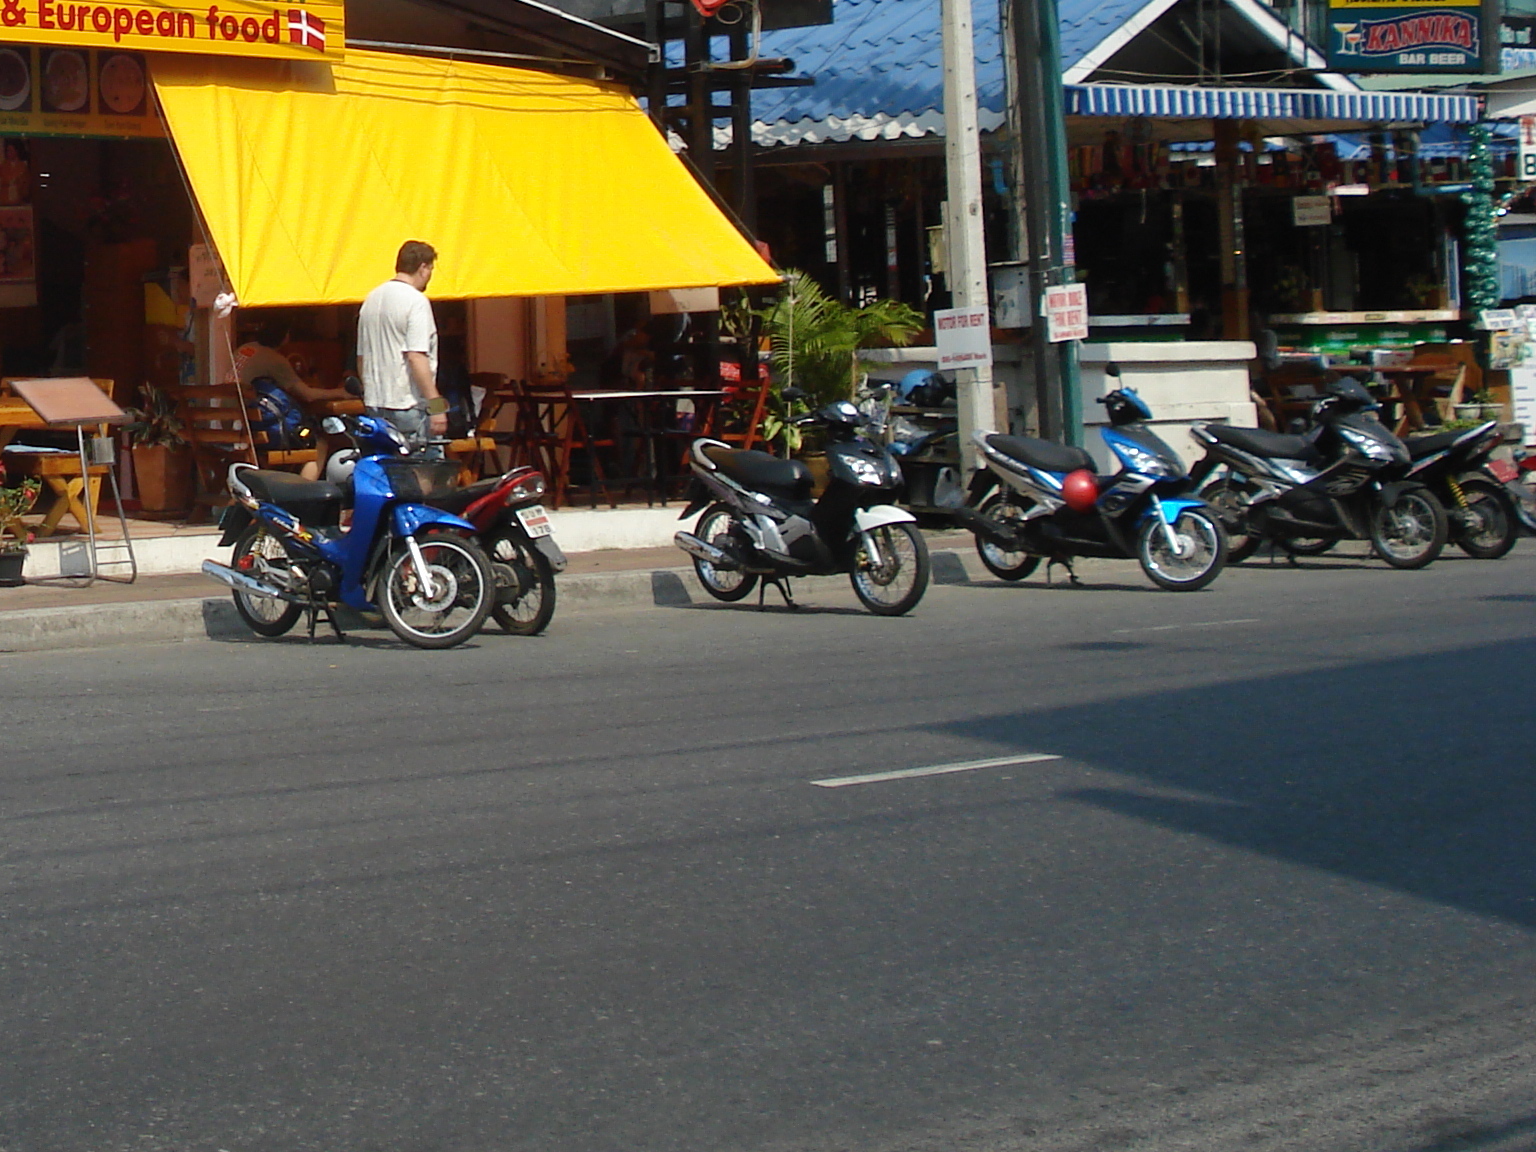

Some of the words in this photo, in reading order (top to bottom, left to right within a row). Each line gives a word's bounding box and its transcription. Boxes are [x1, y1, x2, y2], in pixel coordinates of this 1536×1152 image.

[205, 5, 280, 44] food
[1366, 14, 1472, 51] KANNIKA
[1399, 53, 1425, 65] BAR
[1429, 53, 1466, 65] BEER
